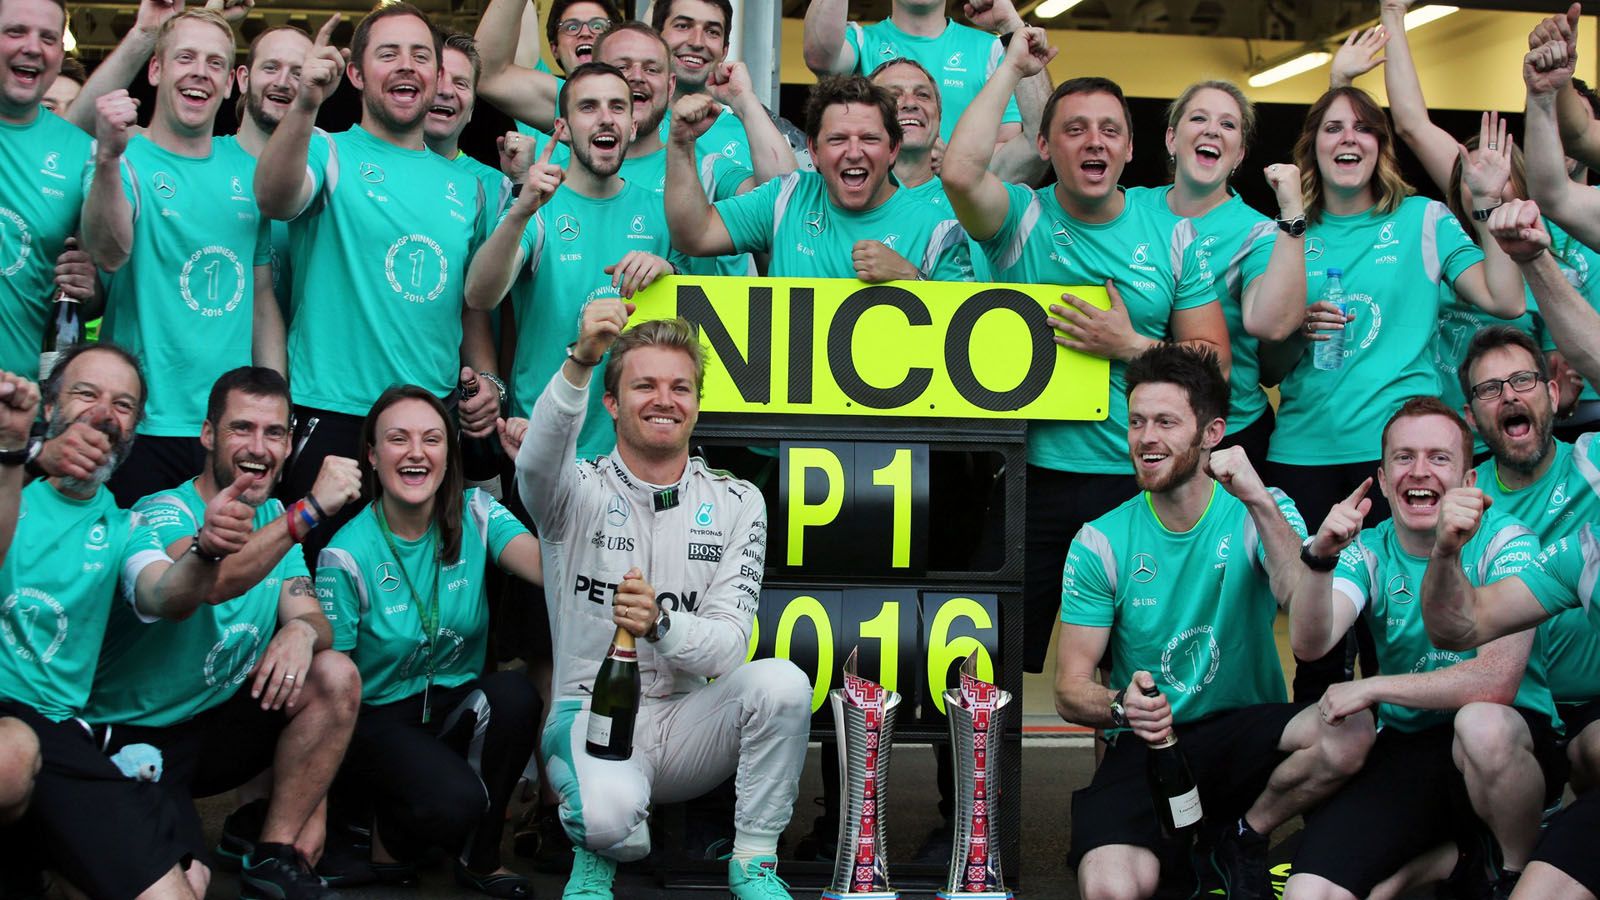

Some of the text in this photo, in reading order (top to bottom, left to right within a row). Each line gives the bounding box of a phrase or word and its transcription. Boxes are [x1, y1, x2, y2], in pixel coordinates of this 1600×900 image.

[397, 233, 443, 256] GP WINNERS
[191, 245, 238, 263] GP WINNERS
[1132, 280, 1157, 289] BOSS
[403, 291, 425, 303] 2016
[201, 307, 223, 317] 2016
[676, 284, 1058, 412] NICO
[787, 447, 913, 569] P1
[690, 528, 723, 537] PETRONAS
[607, 536, 635, 551] UBS
[690, 544, 723, 558] BOSS
[393, 603, 408, 613] UBS
[1168, 637, 1178, 650] GP
[745, 595, 994, 716] 016
